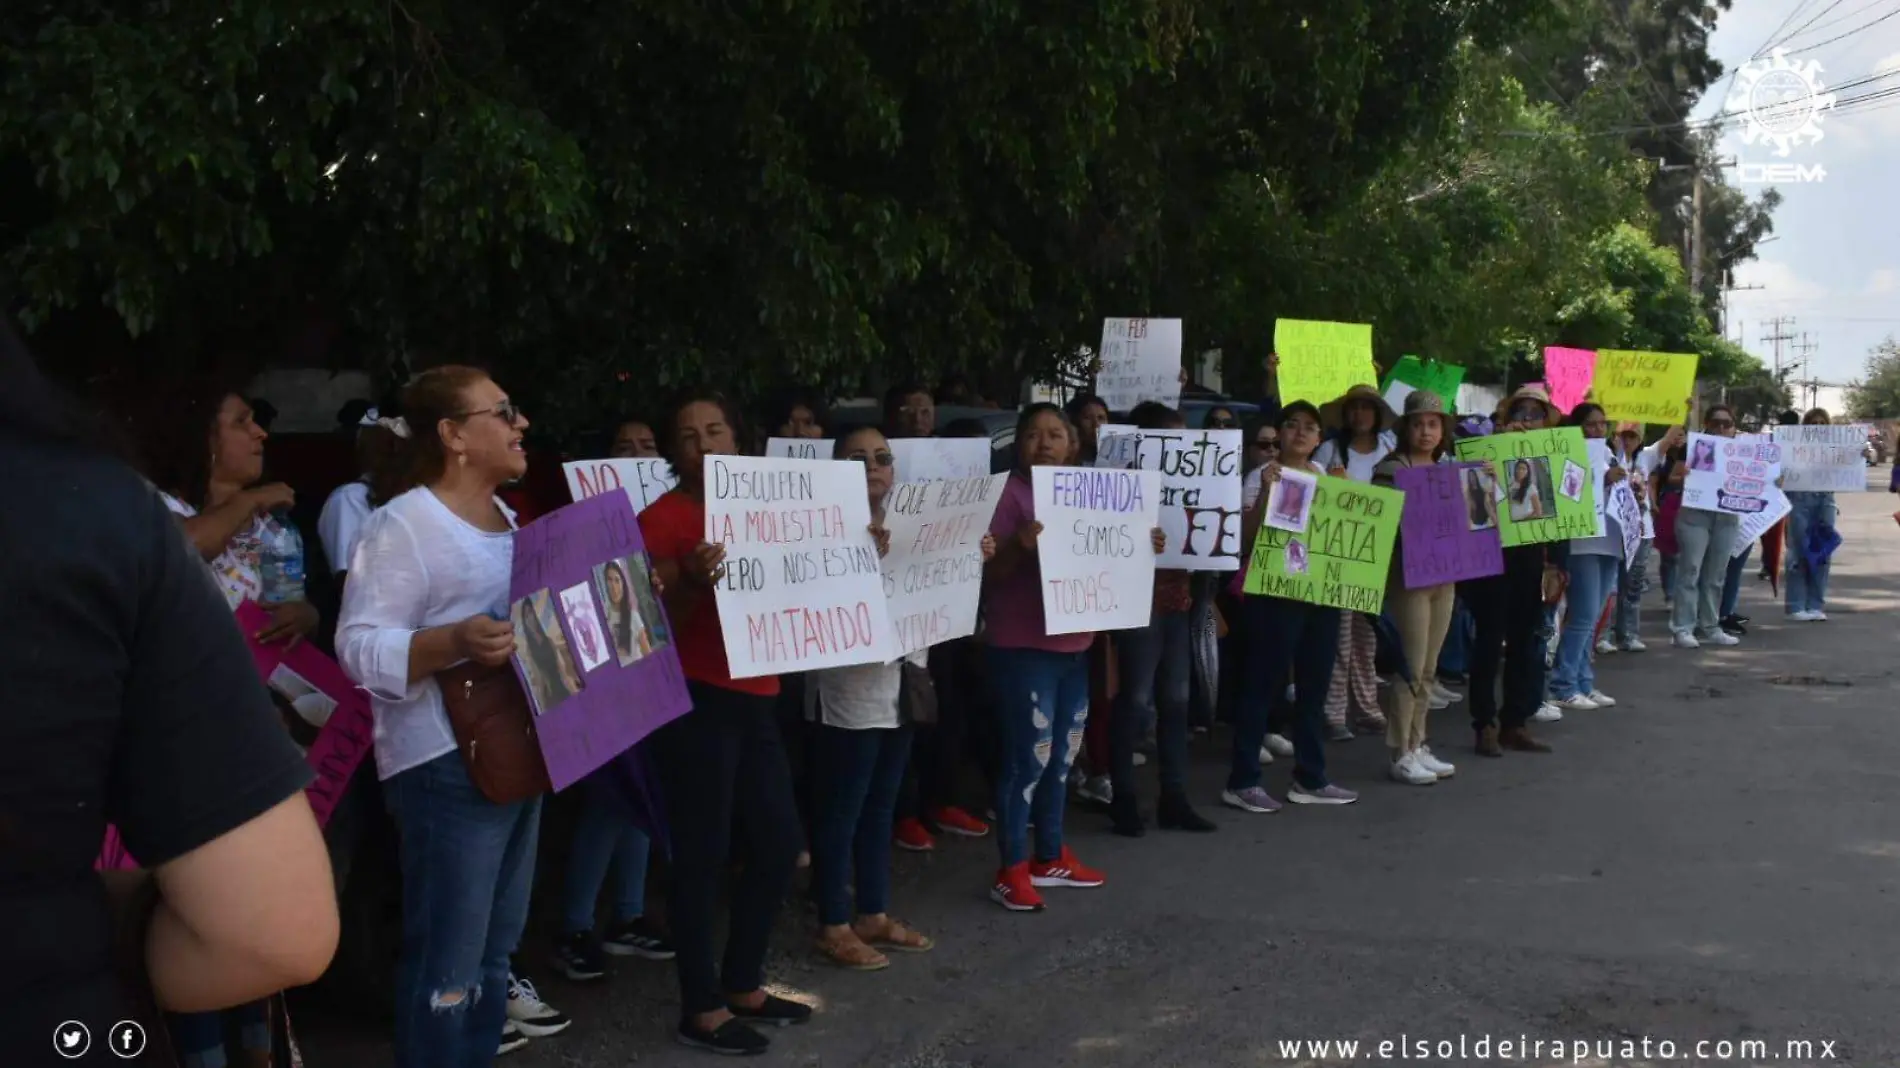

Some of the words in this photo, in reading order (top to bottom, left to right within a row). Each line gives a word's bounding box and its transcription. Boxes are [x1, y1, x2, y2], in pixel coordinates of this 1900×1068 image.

[1128, 318, 1148, 339] FER
[1608, 371, 1653, 389] Para
[573, 463, 622, 499] NO
[1052, 471, 1145, 512] FERNANDA
[710, 512, 735, 545] LA
[745, 503, 845, 545] MOLESTIA
[1337, 490, 1385, 518] ama
[1072, 518, 1136, 559] SOMOS
[1307, 513, 1377, 564] MATA
[783, 551, 818, 585] NOS
[823, 545, 878, 577] ESTAN
[1252, 549, 1270, 571] NI
[1325, 561, 1343, 583] NI
[746, 601, 872, 663] MATANDO
[894, 604, 952, 653] VIVAS
